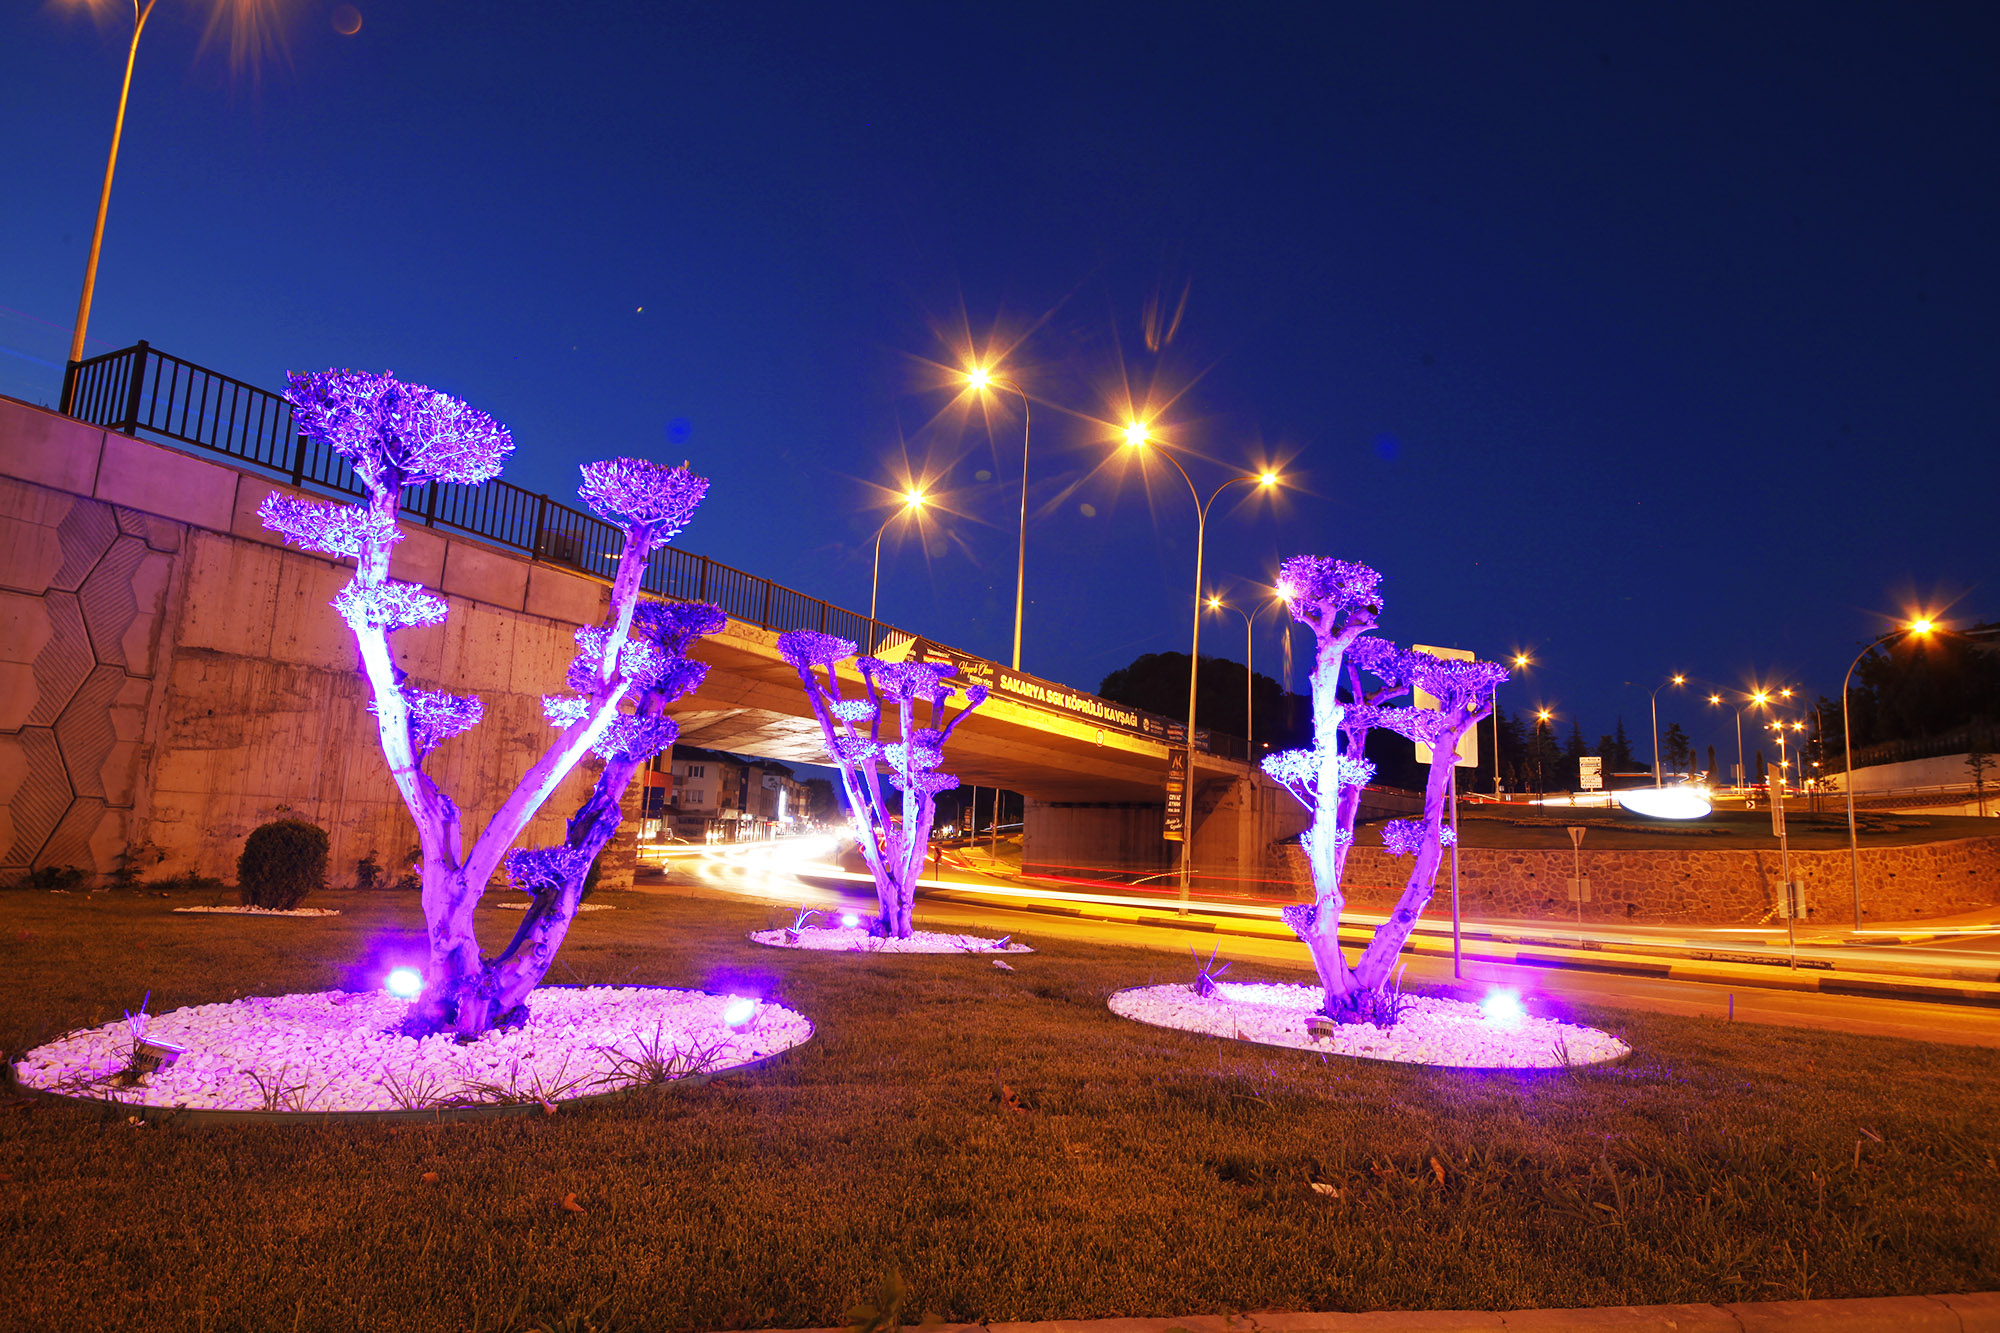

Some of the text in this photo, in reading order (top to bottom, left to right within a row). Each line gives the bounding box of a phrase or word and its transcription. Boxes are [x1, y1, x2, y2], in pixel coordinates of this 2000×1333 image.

[1000, 675, 1045, 701] SAKARYA
[1046, 689, 1065, 707] SGK
[1065, 694, 1104, 718] KÖPRÜLÜ
[1104, 706, 1138, 728] KAVŞAĞI
